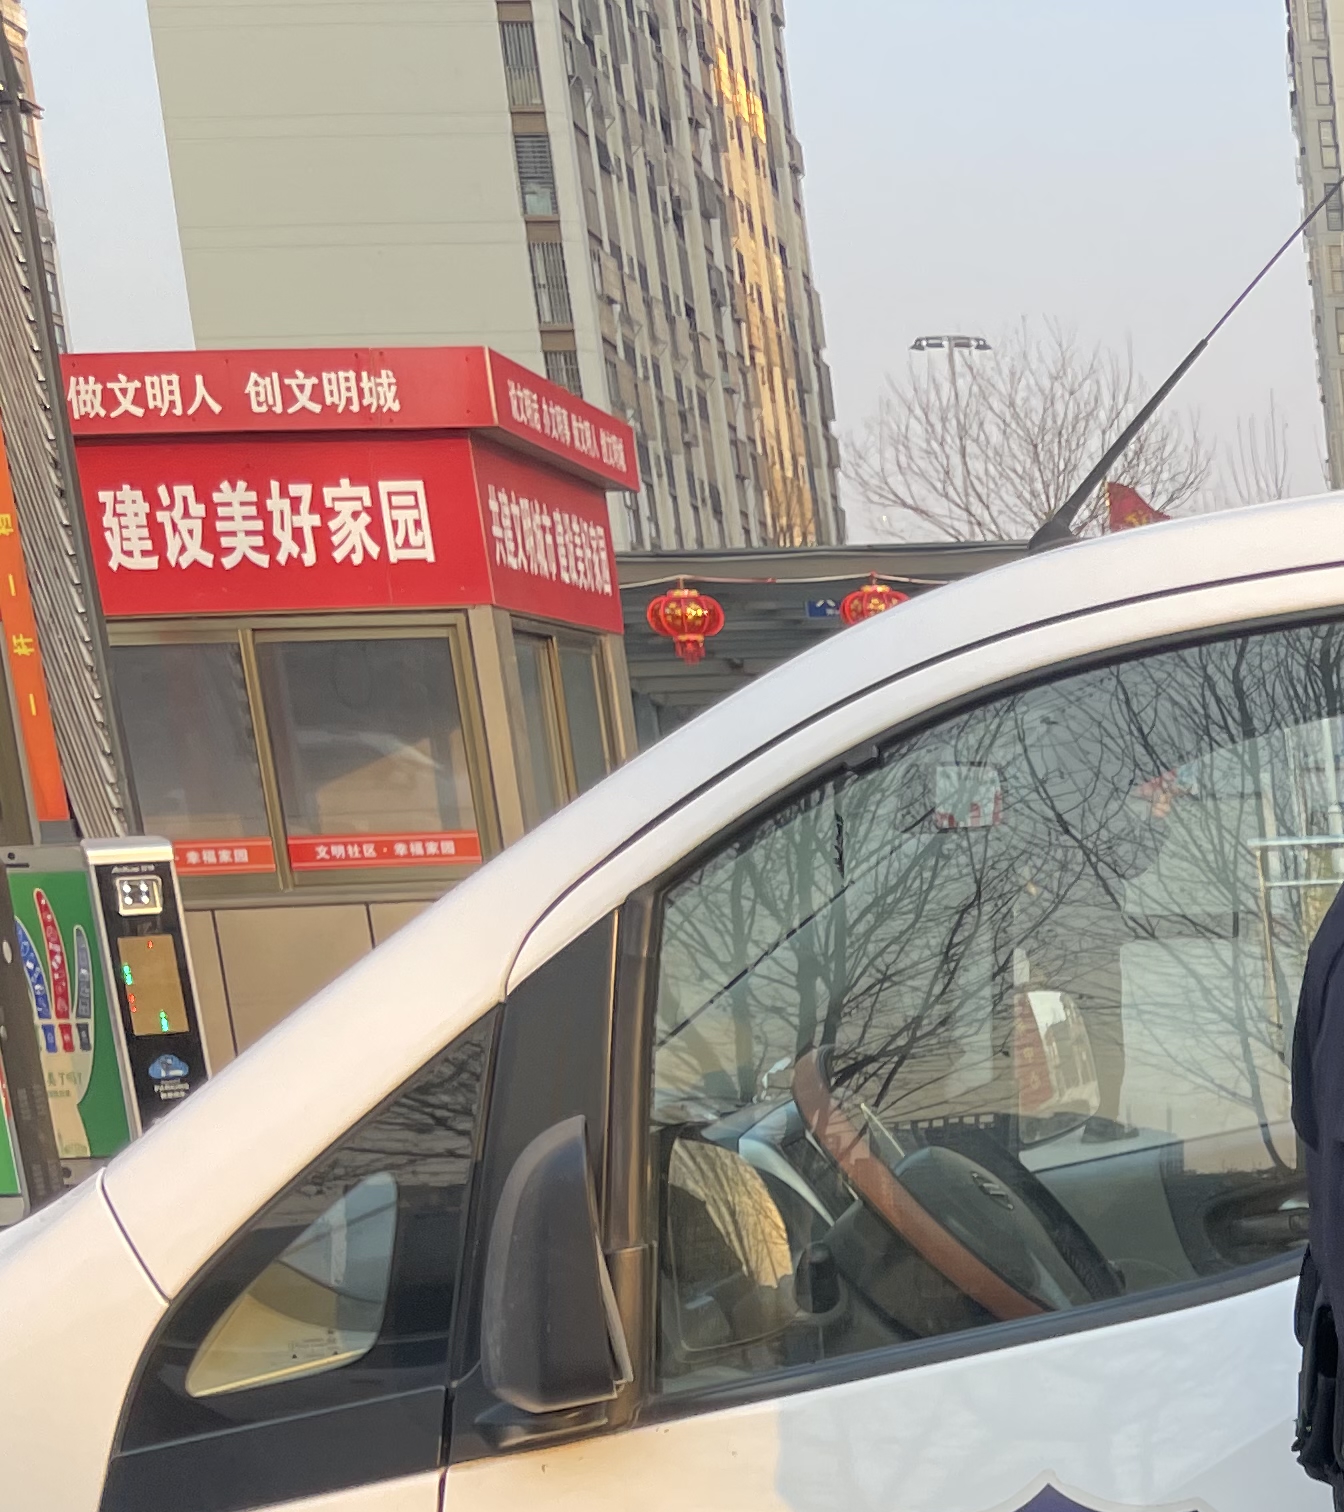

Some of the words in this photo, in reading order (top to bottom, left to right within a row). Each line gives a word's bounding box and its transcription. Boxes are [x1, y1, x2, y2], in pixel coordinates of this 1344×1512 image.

[67, 373, 223, 420] 做文明人
[244, 369, 401, 414] 创文明城
[97, 477, 436, 572] 建设美好家园
